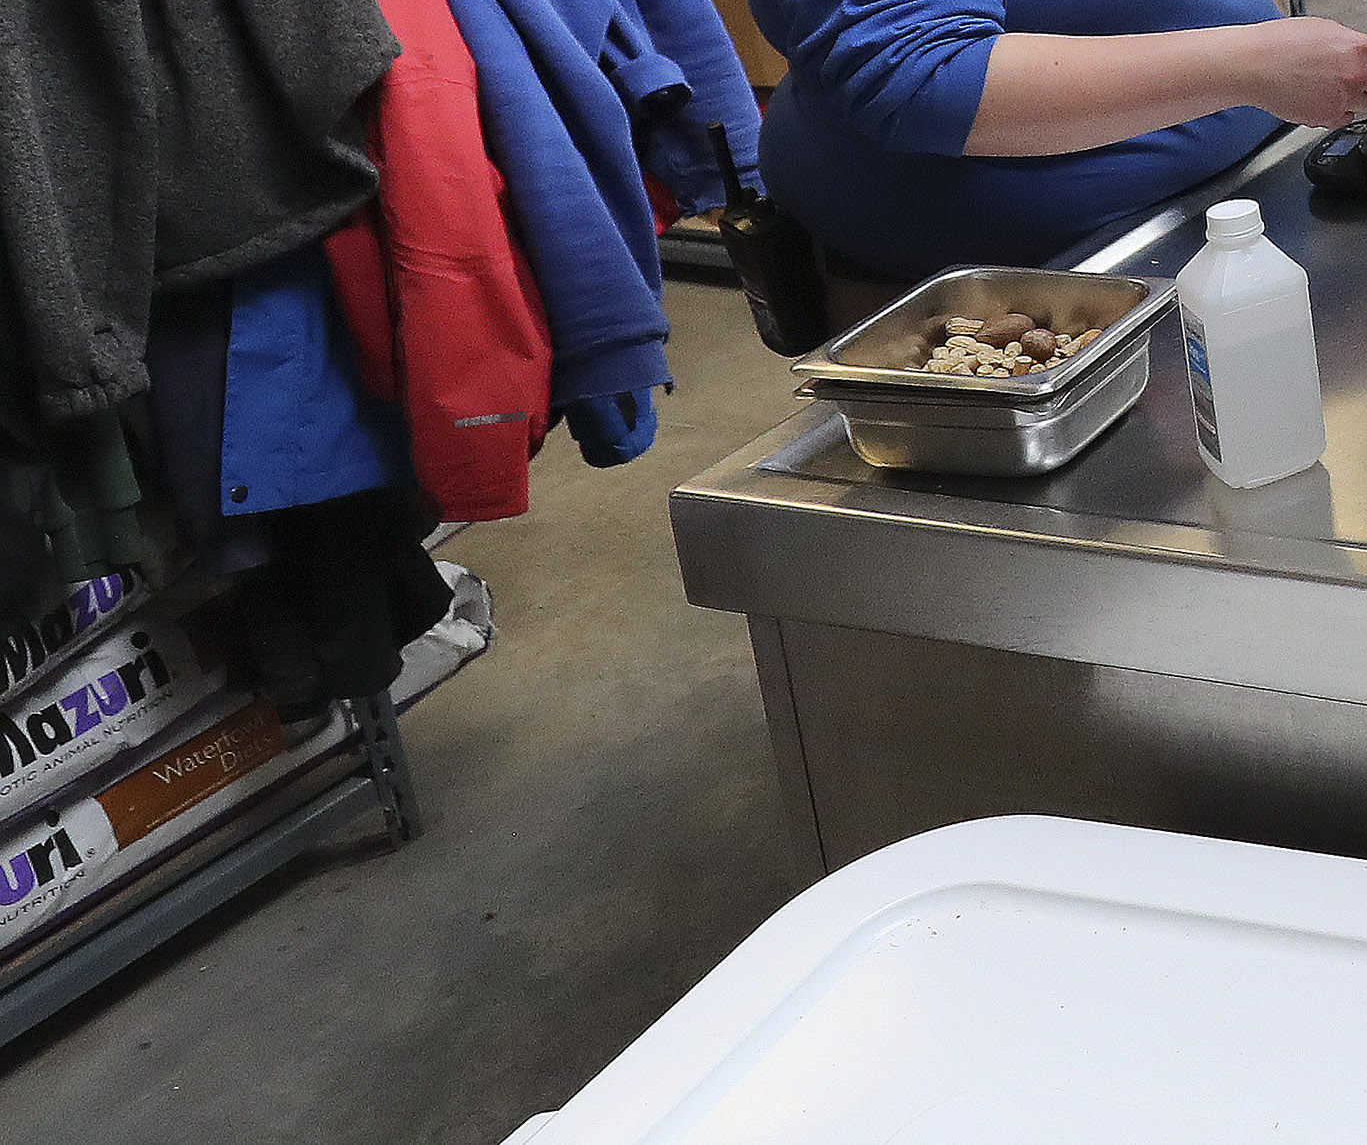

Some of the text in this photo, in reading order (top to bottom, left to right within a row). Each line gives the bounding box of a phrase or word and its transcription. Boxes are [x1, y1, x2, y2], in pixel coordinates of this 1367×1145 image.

[0, 770, 37, 795] OTIC
[44, 738, 101, 772] ANIMAL
[0, 809, 84, 906] uri
